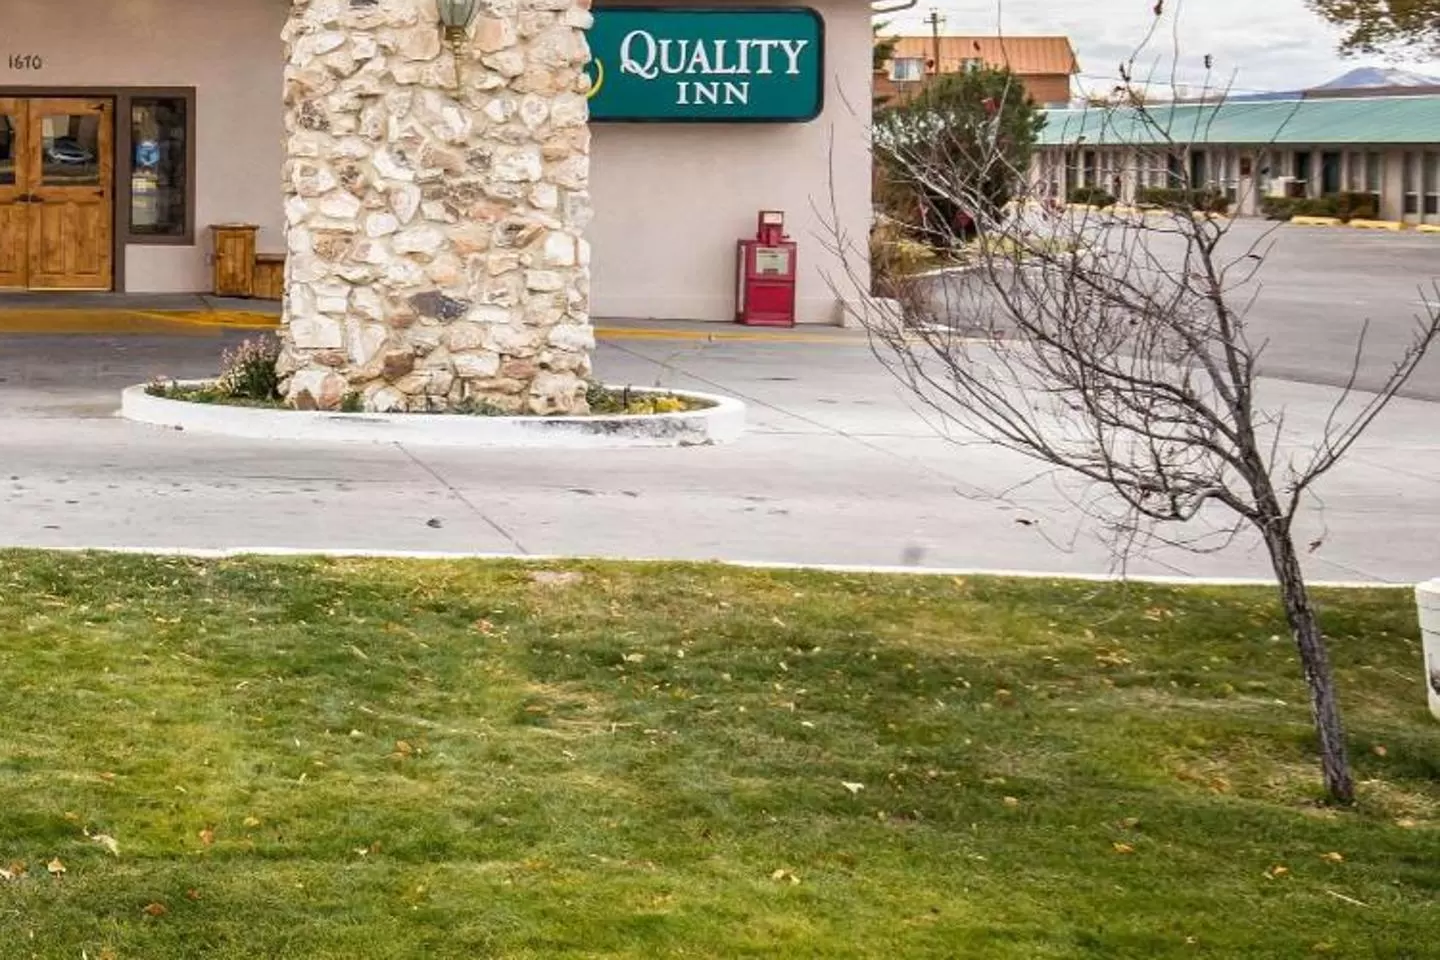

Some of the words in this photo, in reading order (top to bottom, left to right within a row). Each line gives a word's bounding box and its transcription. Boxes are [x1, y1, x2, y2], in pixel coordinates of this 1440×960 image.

[8, 54, 42, 70] 1670
[619, 29, 808, 80] QUALITY
[675, 81, 750, 105] INN
